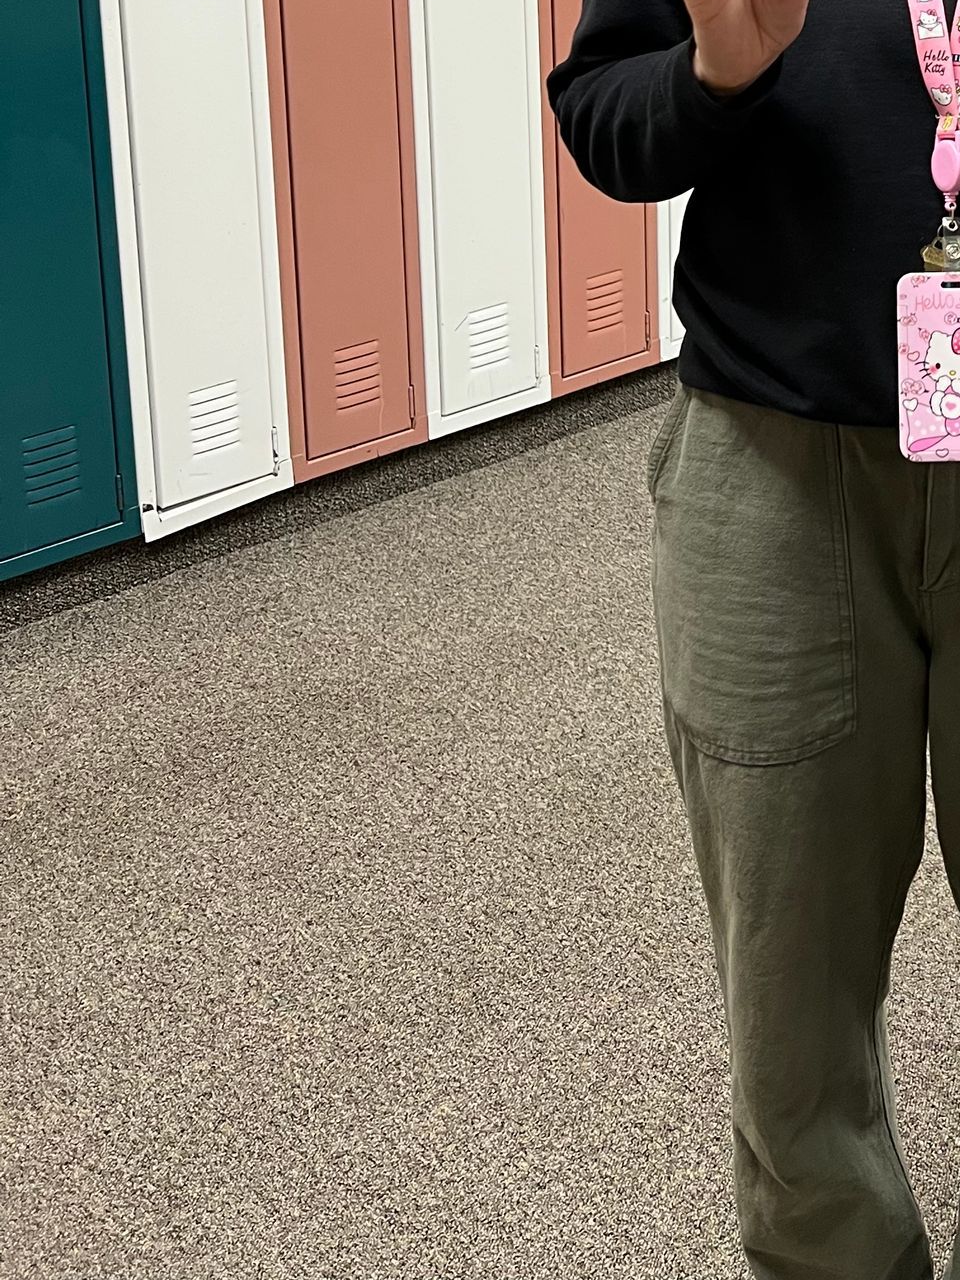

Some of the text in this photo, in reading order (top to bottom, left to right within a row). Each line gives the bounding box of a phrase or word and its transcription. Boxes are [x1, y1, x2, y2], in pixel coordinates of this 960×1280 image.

[923, 49, 950, 62] Hello
[924, 61, 945, 76] Kitty
[914, 292, 954, 312] Hello
